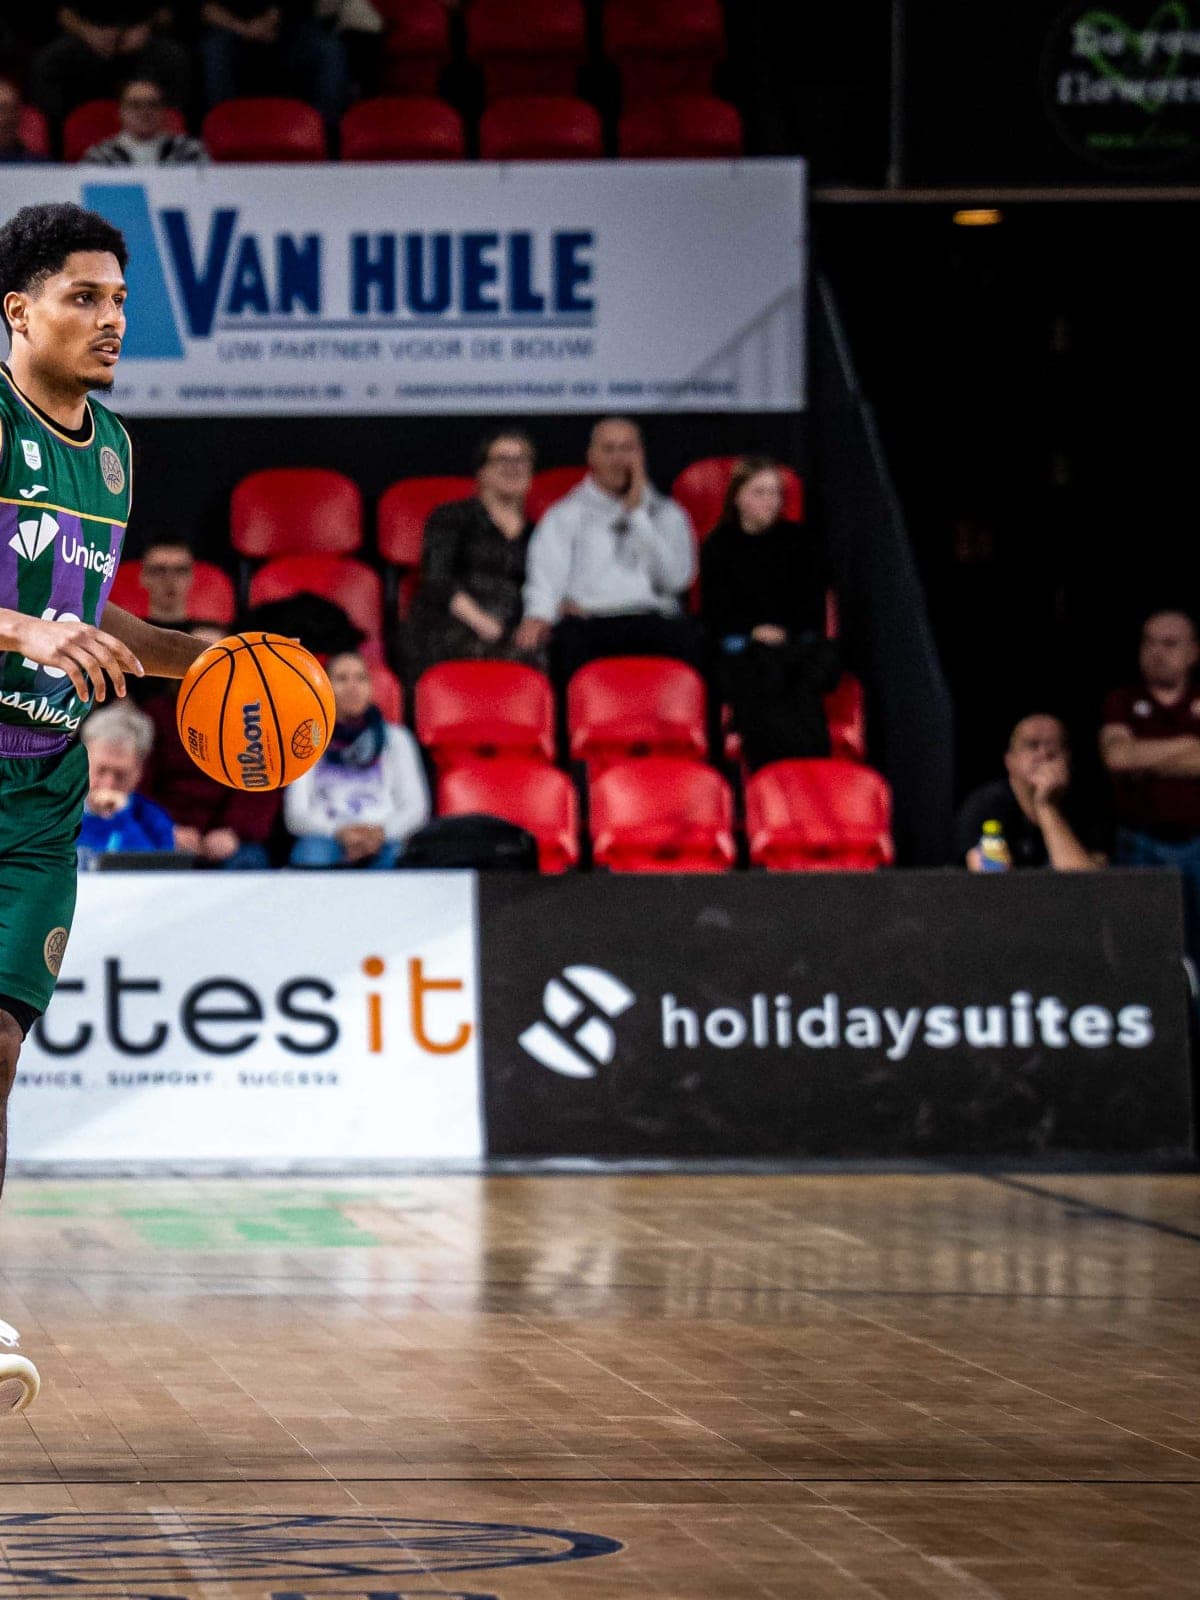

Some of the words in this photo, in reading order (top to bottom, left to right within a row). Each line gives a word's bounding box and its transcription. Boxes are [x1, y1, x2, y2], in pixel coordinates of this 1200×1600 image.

[161, 207, 321, 340] VAN
[349, 229, 595, 318] HUELE
[269, 339, 382, 361] PARTNER
[389, 339, 463, 361] VOOR
[470, 338, 504, 360] DE
[510, 337, 596, 359] BOUW
[188, 726, 199, 758] FIBA
[237, 699, 270, 788] Wilson
[660, 991, 1153, 1061] holidaysuites
[16, 1070, 83, 1087] RVICE
[106, 1070, 212, 1087] SUPPORT
[238, 1070, 338, 1086] SUCCESS
